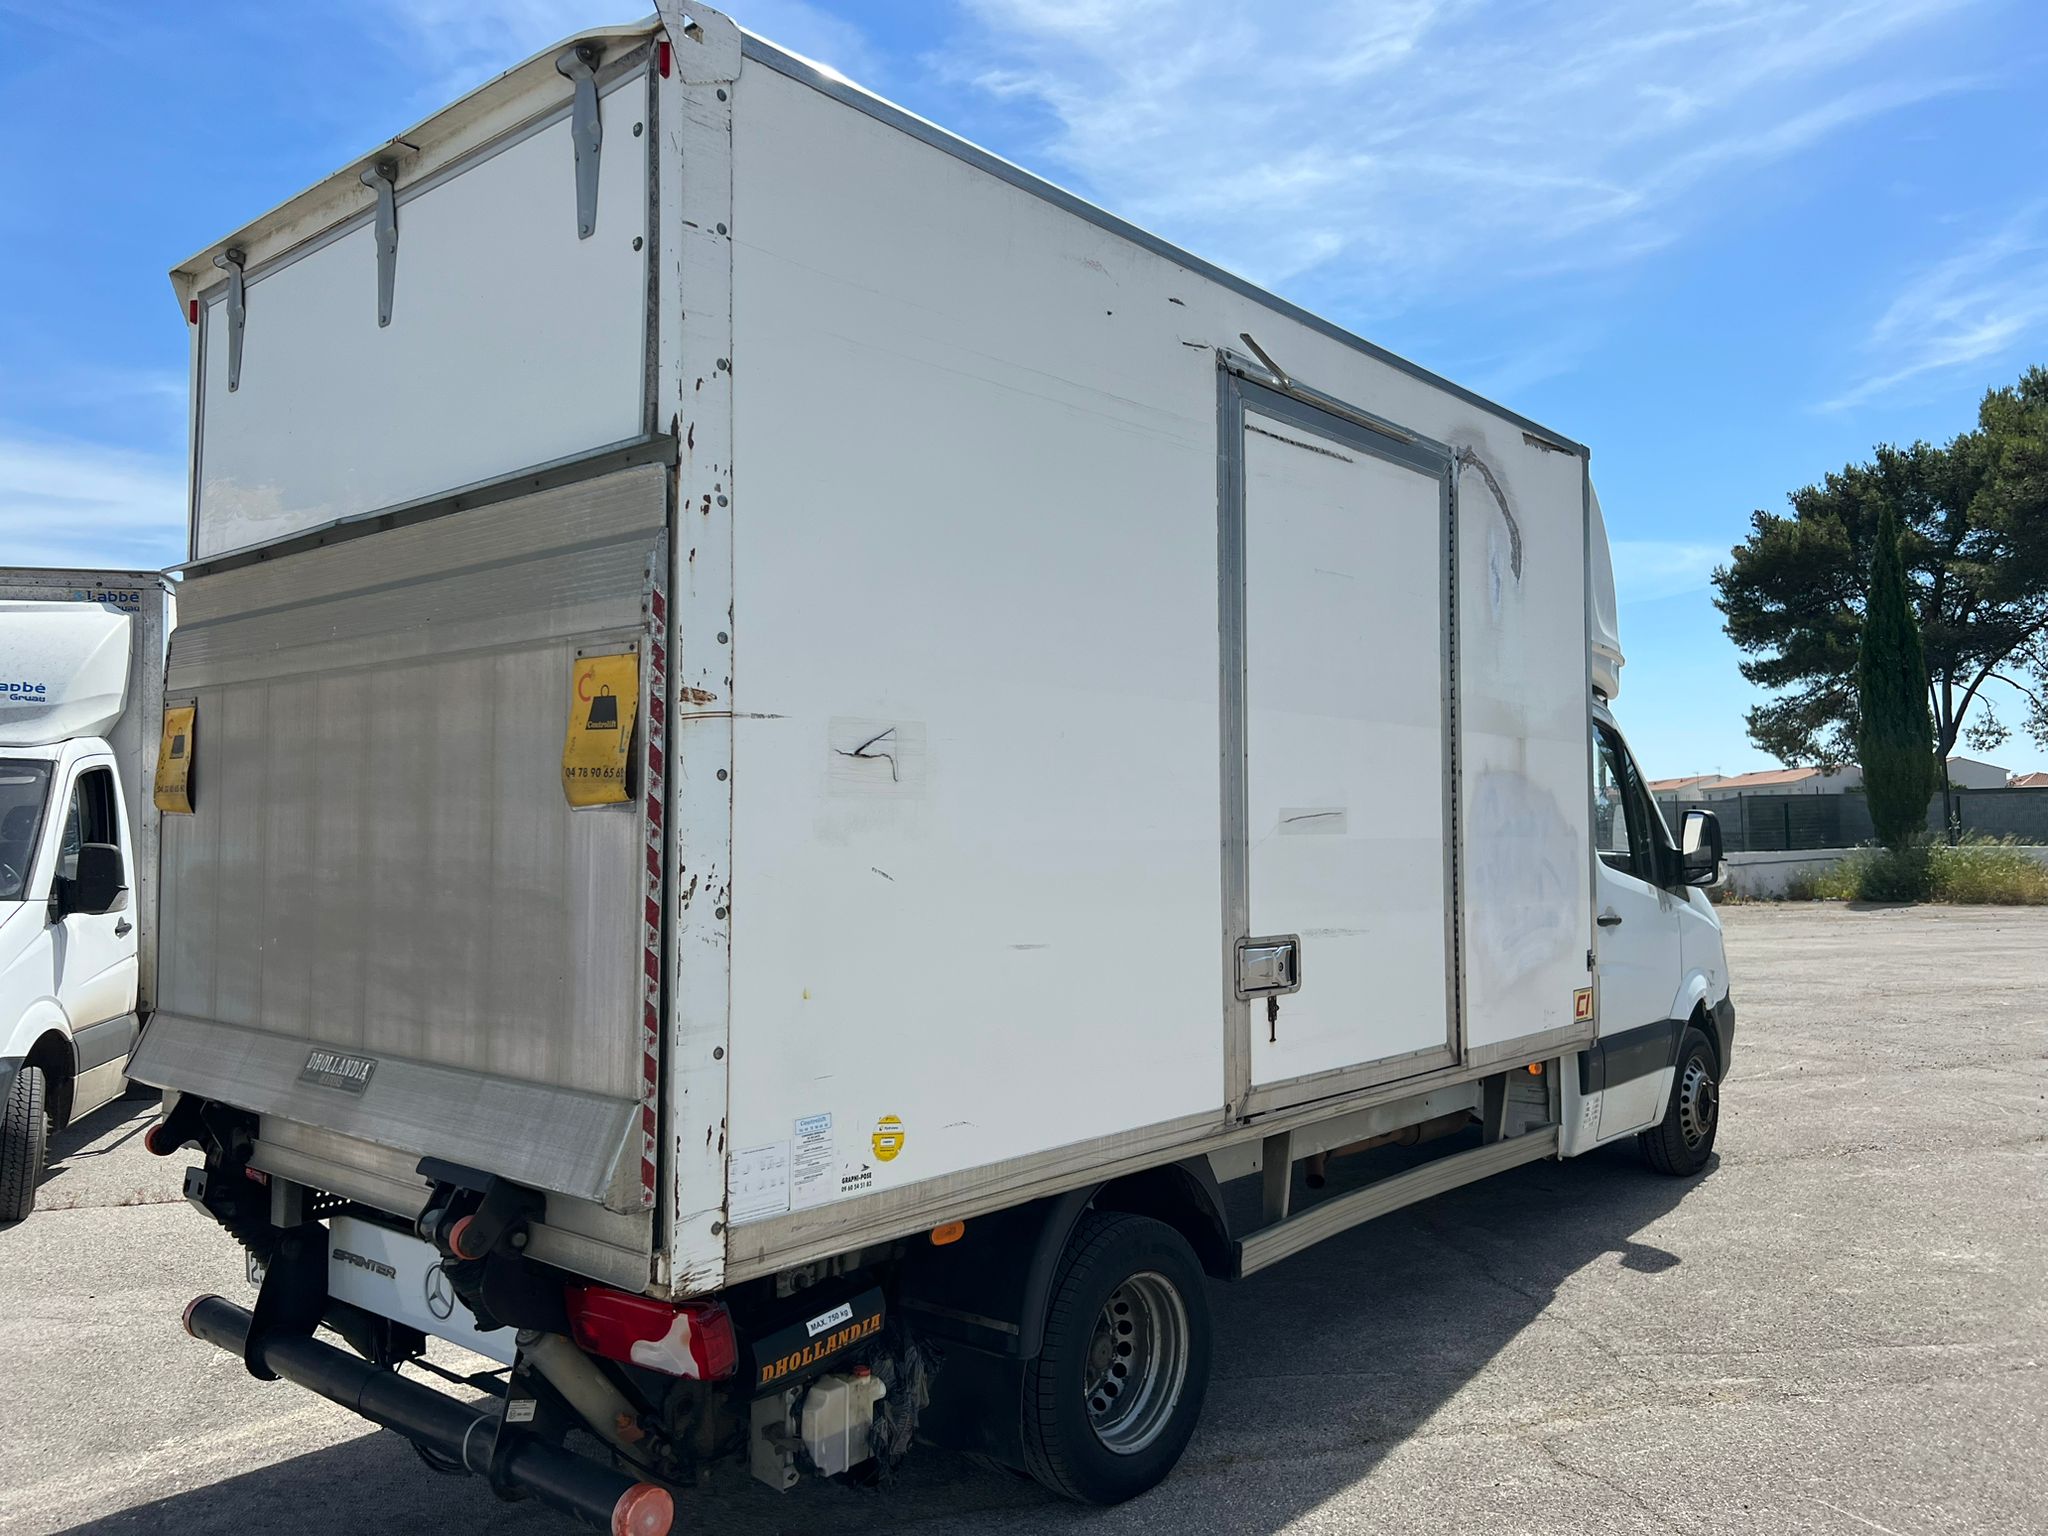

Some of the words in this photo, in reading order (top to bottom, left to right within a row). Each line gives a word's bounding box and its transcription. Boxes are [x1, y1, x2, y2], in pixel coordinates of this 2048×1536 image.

[0, 682, 46, 694] abbé
[9, 693, 46, 702] Gruau
[565, 767, 576, 778] 04
[578, 767, 589, 778] 78
[590, 767, 602, 778] 90
[603, 767, 614, 778] 65
[306, 1052, 370, 1081] DHOLLANDIA
[332, 1248, 397, 1280] SPRINTER
[810, 1320, 827, 1331] MAX.
[827, 1312, 840, 1323] 750
[840, 1309, 849, 1318] kg
[762, 1313, 881, 1384] DHOLLANDIA
